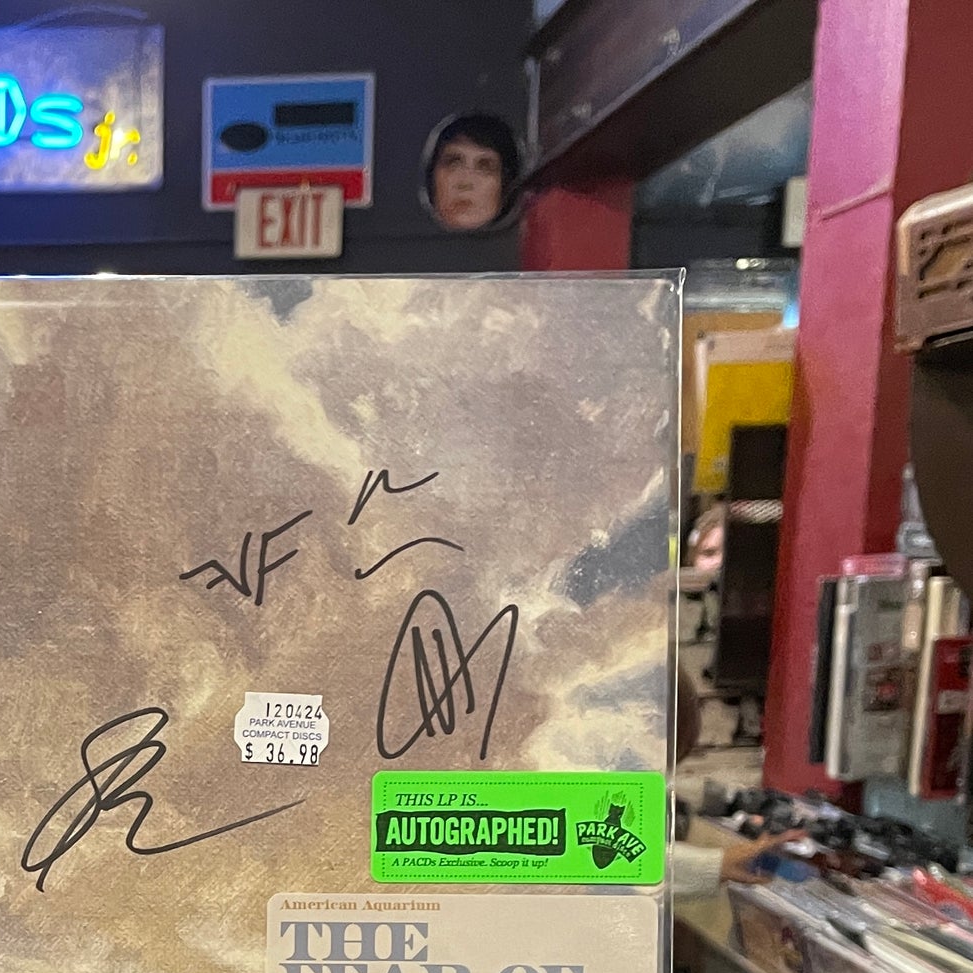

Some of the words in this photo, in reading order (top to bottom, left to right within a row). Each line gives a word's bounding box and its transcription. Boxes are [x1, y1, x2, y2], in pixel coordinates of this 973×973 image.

[85, 110, 141, 171] jr.
[256, 192, 325, 249] EXIT
[266, 702, 323, 720] 120424
[249, 717, 276, 728] PARK
[277, 719, 317, 730] AVENUE
[242, 729, 290, 740] COMPACT
[292, 732, 323, 741] DISCS
[245, 742, 254, 760] $
[266, 742, 319, 765] 36.98
[395, 793, 434, 807] THIS
[437, 793, 458, 807] LP
[460, 793, 489, 807] IS...
[385, 816, 560, 846] AUTOGRAPHED!
[577, 822, 620, 841] PARK
[612, 832, 645, 856] AVE
[391, 858, 400, 867] A
[402, 857, 437, 867] PACDs
[489, 857, 520, 869] Scoop
[521, 858, 529, 867] it
[531, 857, 549, 870] up!
[280, 899, 358, 911] American
[362, 899, 441, 912] Aquarium
[280, 921, 429, 962] THE
